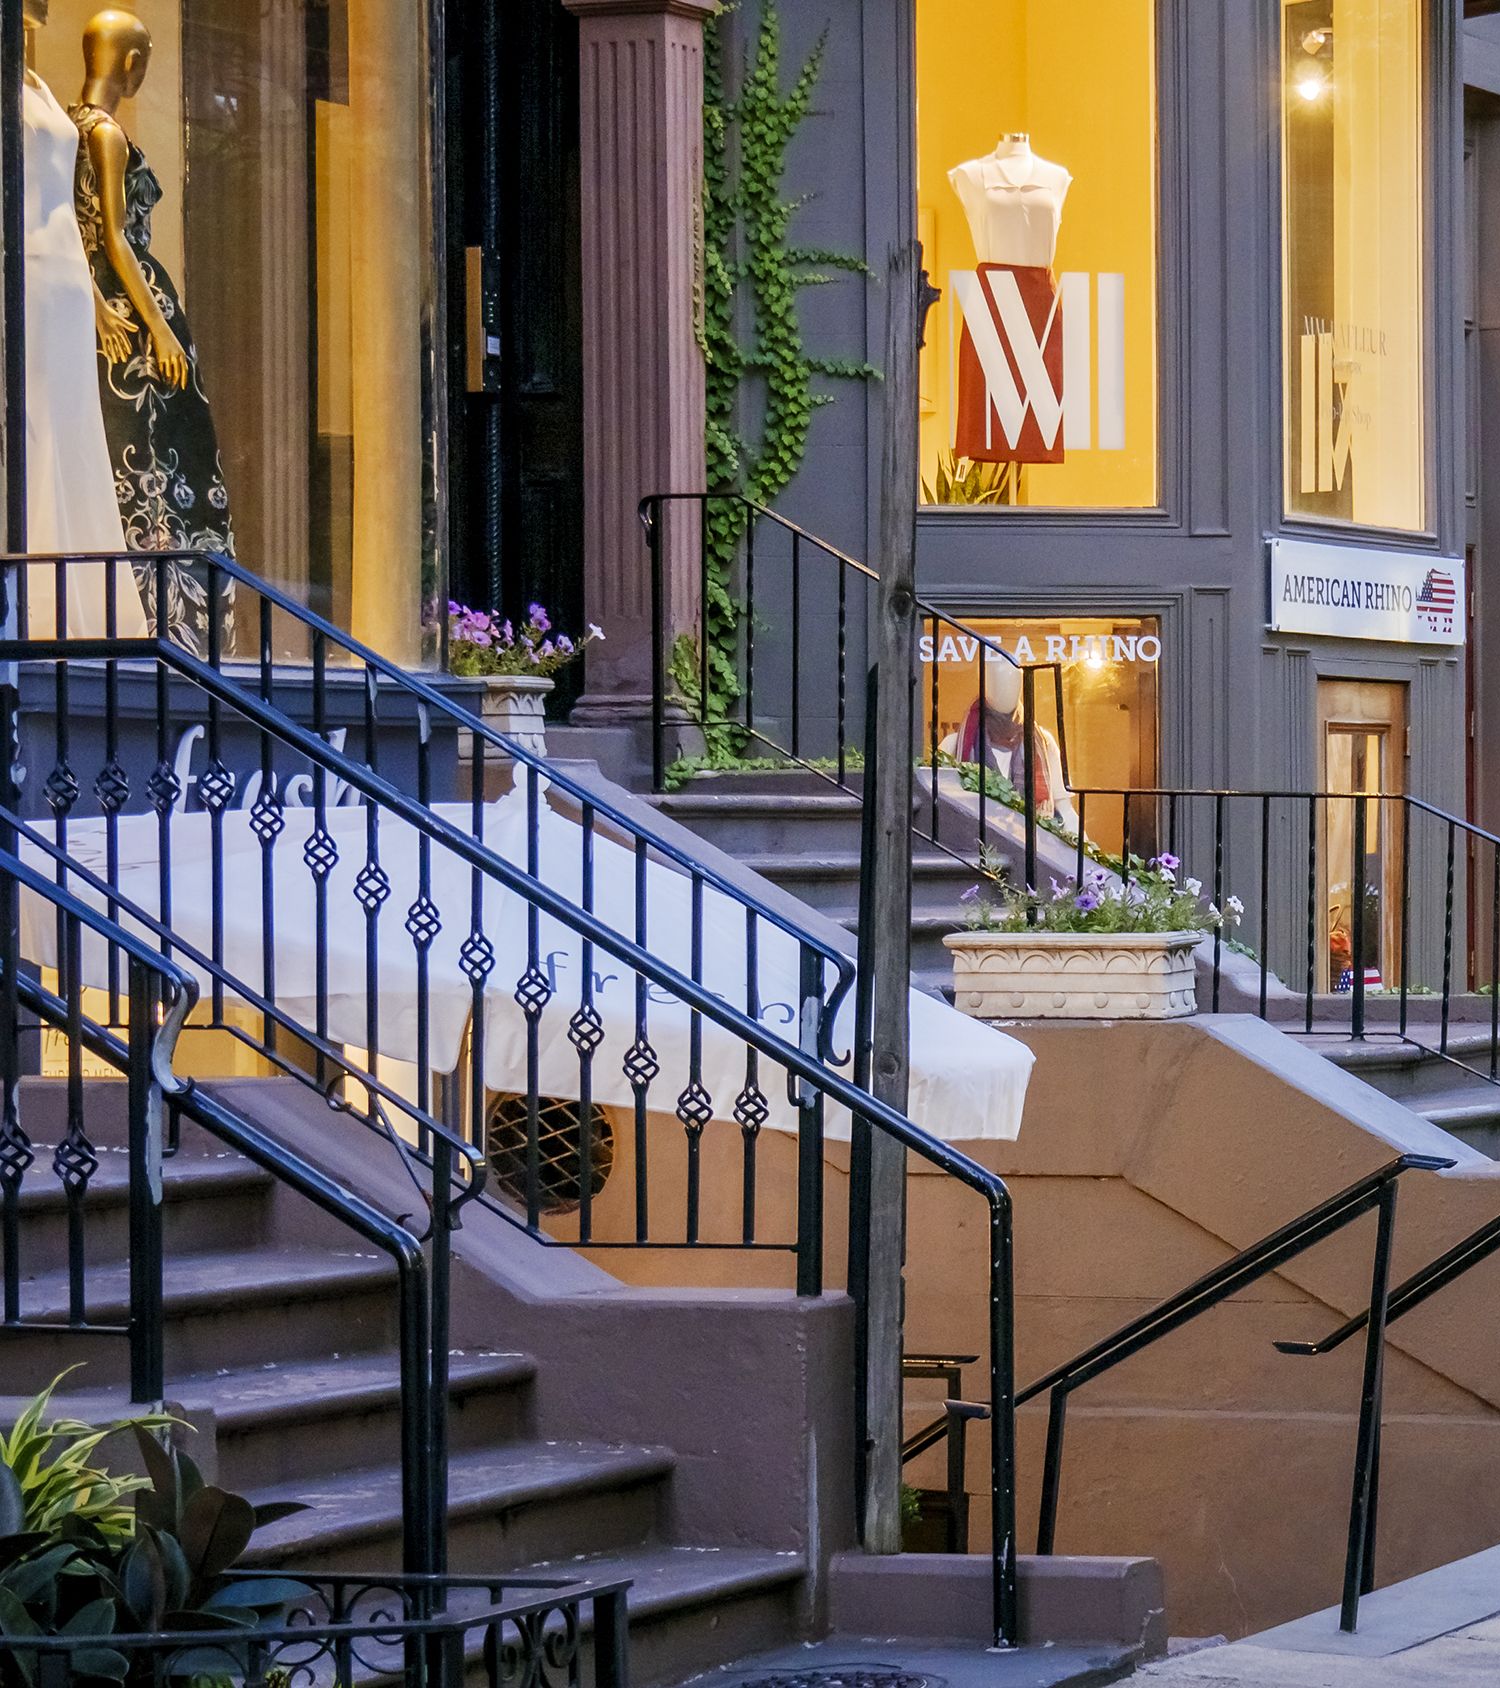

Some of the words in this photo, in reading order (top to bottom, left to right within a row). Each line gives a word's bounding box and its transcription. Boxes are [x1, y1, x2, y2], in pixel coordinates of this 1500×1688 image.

[1282, 573, 1362, 609] AMERICAN
[1365, 582, 1413, 613] RHINO
[919, 636, 1002, 662] SAVE
[1014, 636, 1036, 662] A
[1045, 636, 1162, 662] RHINO
